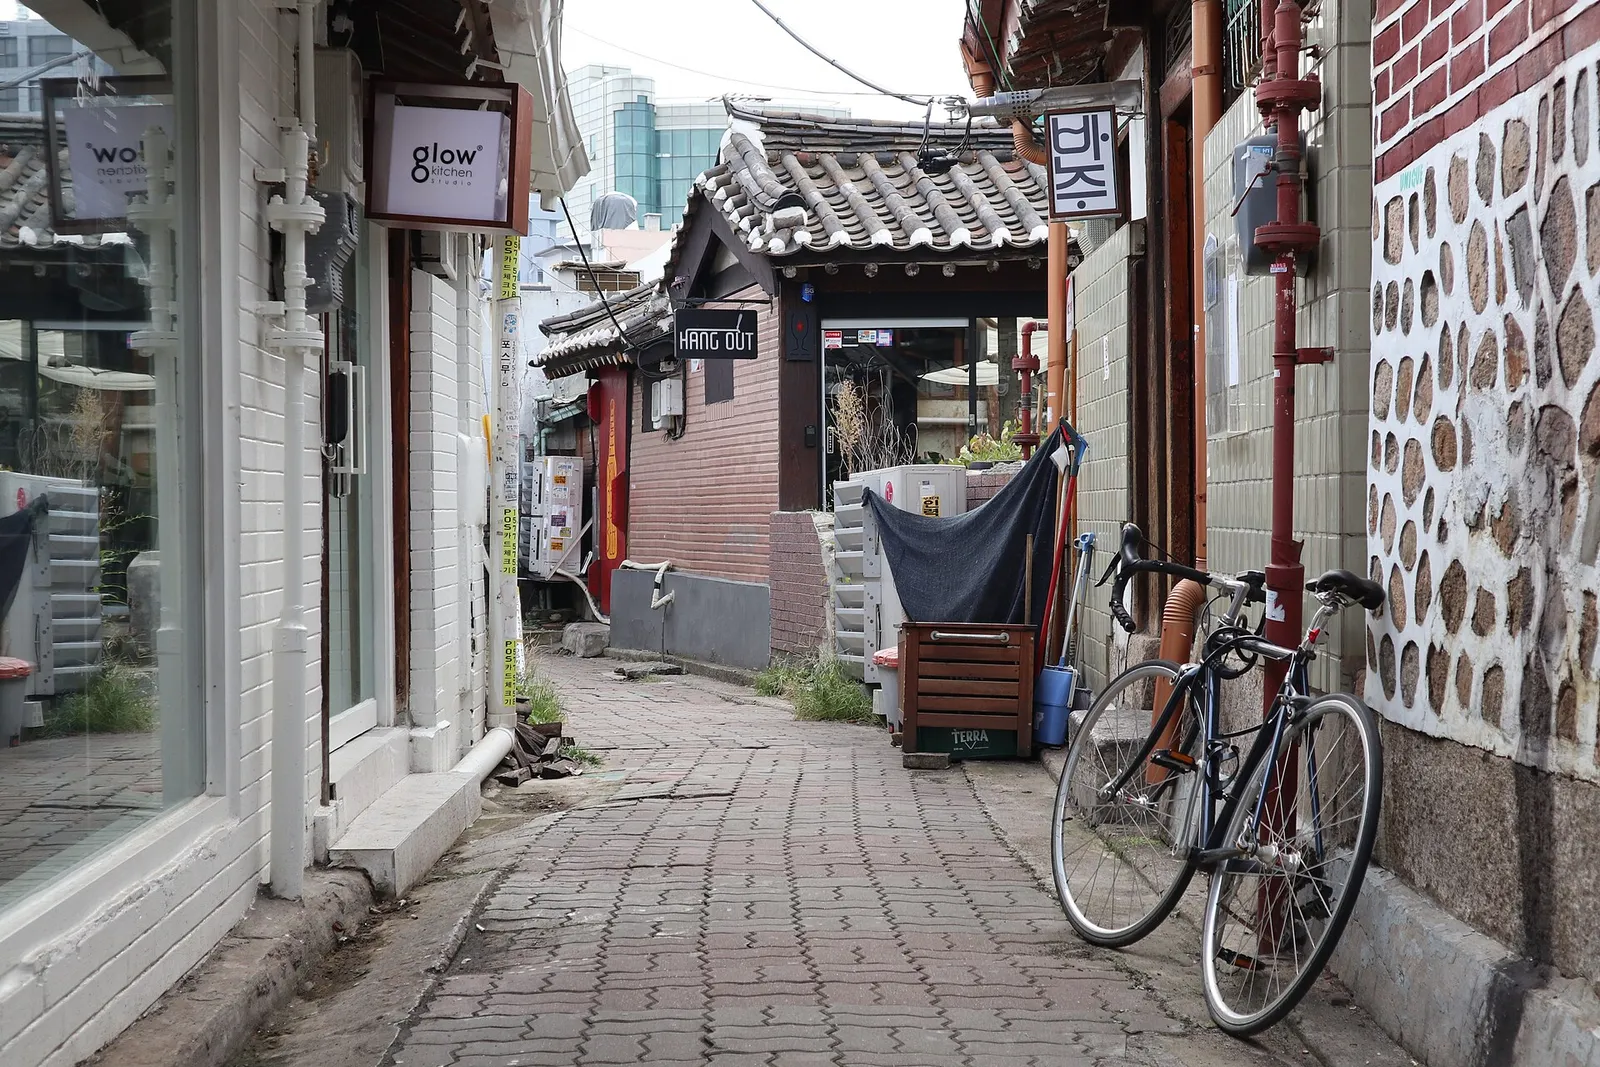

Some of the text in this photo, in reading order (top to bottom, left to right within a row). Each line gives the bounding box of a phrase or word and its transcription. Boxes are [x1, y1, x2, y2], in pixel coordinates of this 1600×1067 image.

[411, 142, 477, 183] glow
[431, 166, 473, 177] kitchen
[680, 329, 754, 351] HANG OUT
[503, 509, 512, 574] POS카드체크기
[504, 641, 512, 705] POS카드체크기
[951, 730, 989, 744] TERRA
